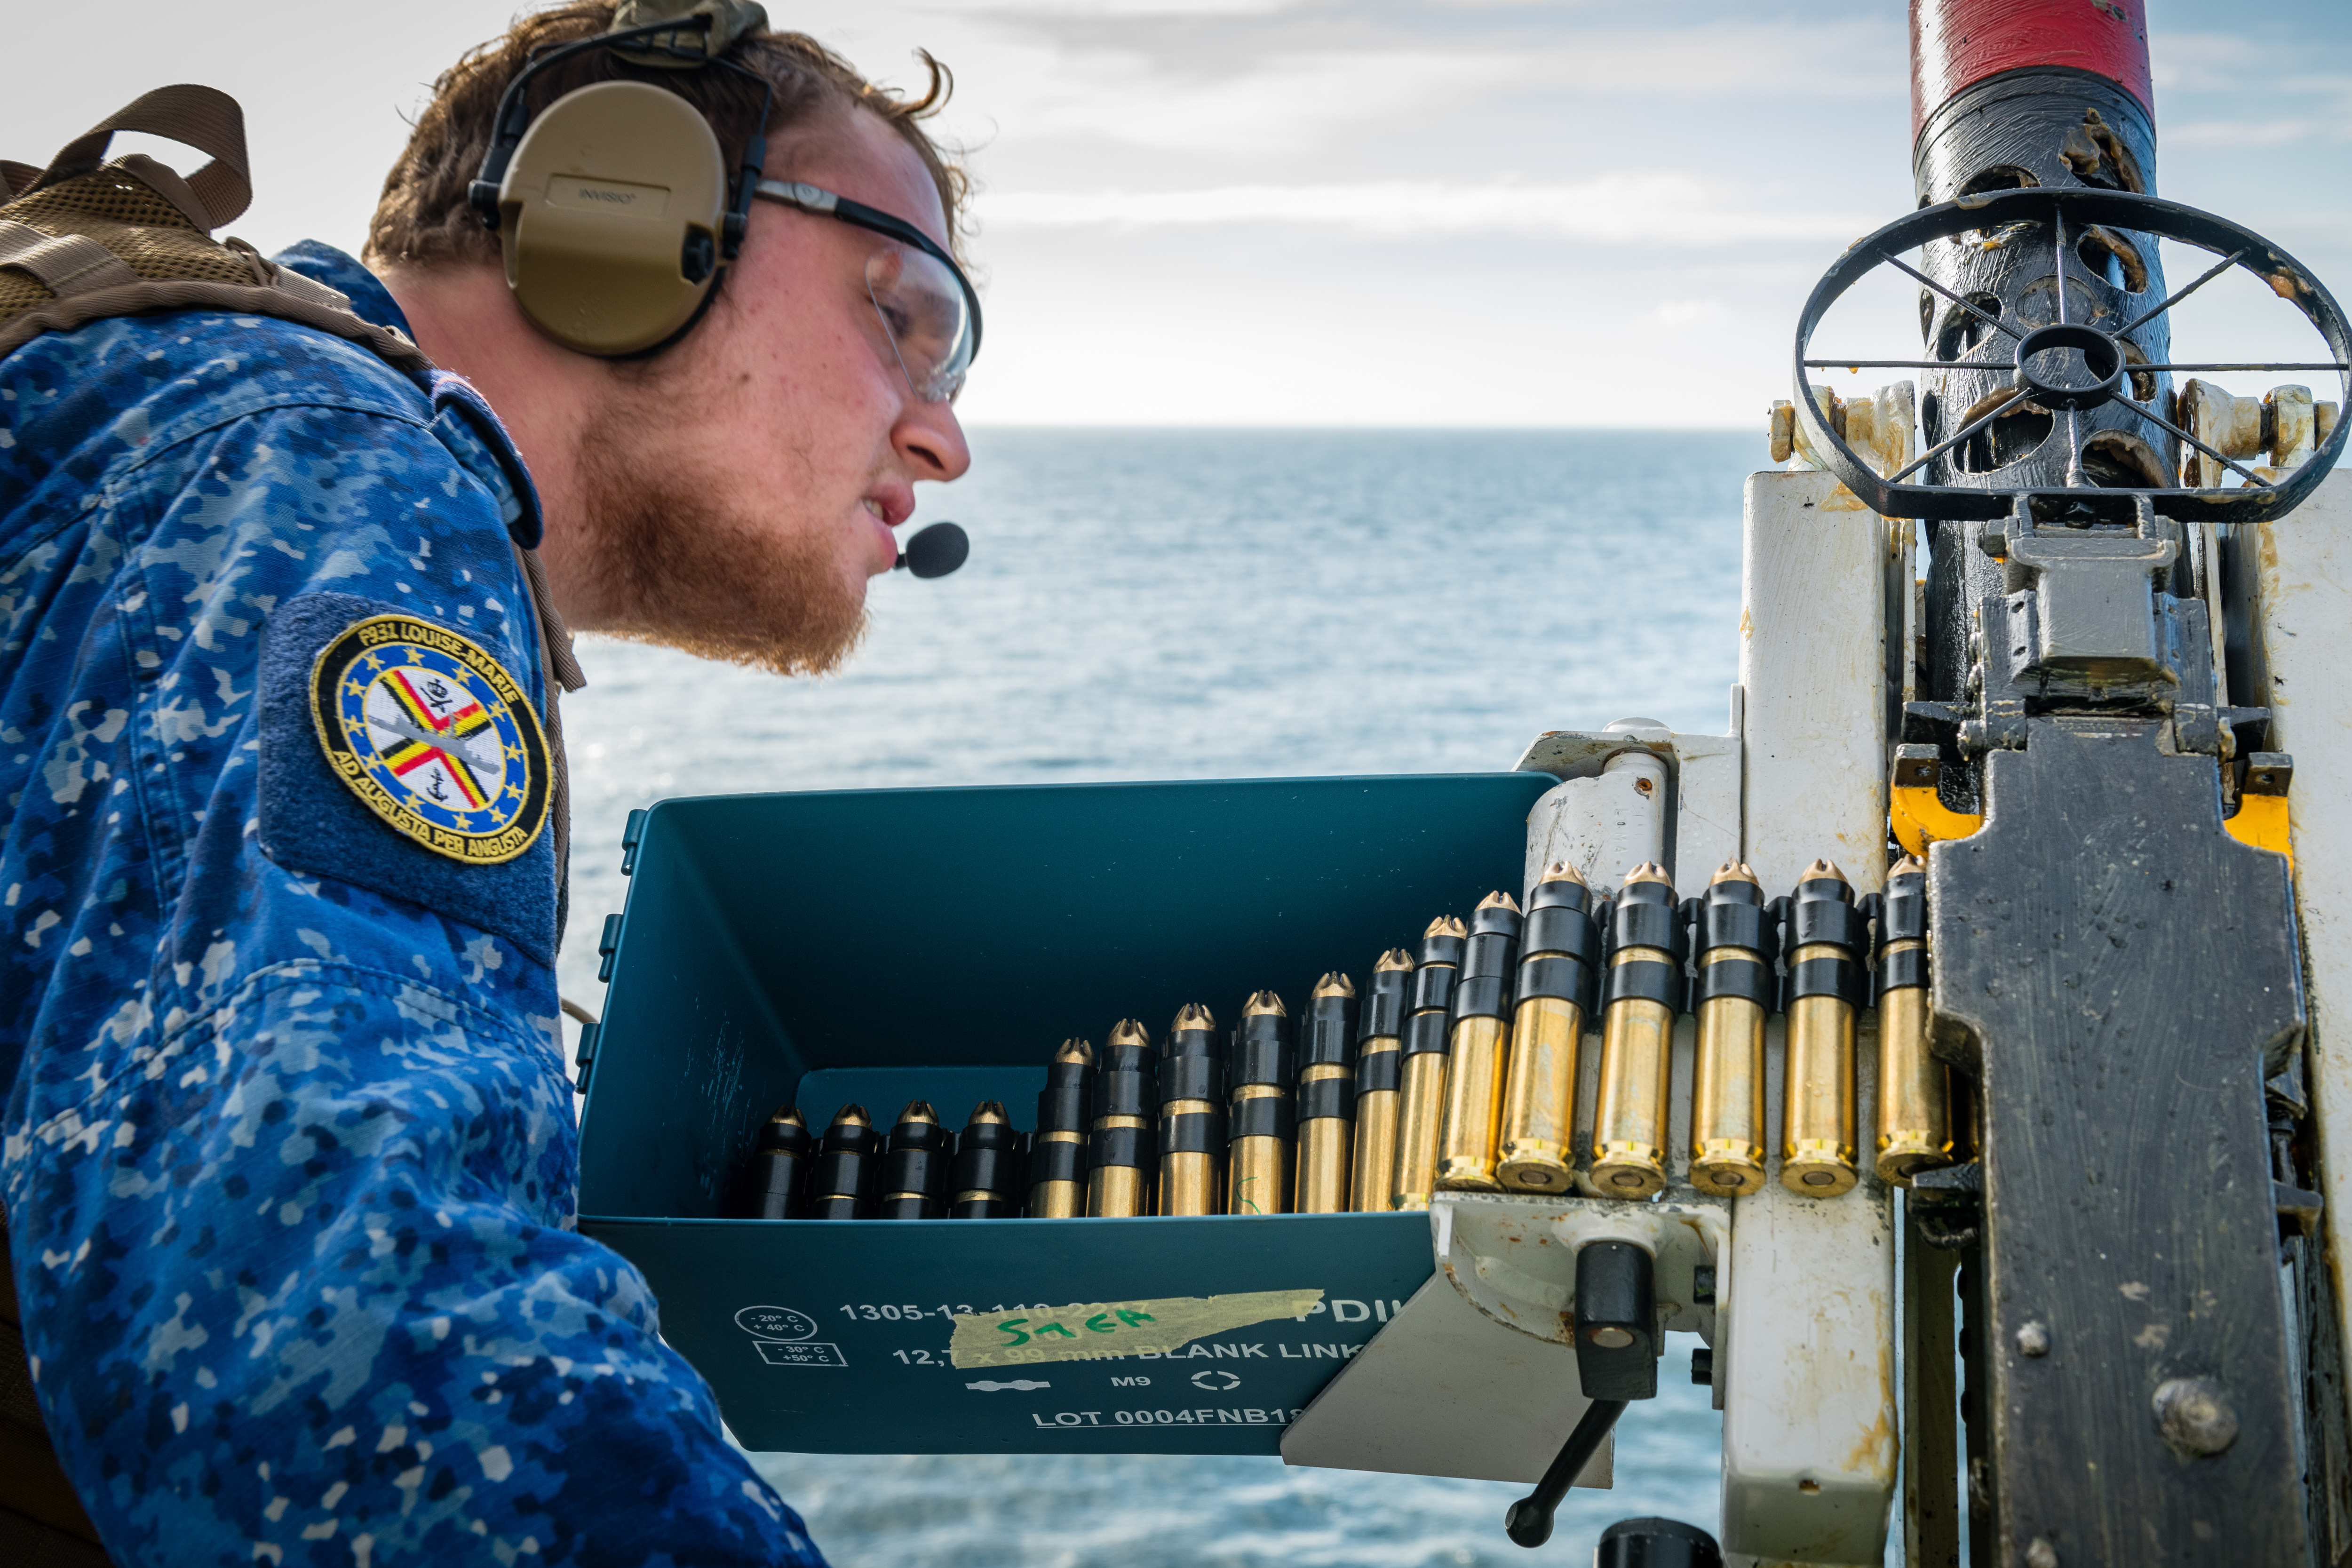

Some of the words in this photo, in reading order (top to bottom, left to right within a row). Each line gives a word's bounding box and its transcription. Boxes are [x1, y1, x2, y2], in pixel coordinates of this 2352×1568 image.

[358, 622, 399, 646] F931
[400, 626, 520, 704] LOUISE-MARIE
[333, 750, 360, 776] AD
[357, 777, 431, 842] AUGUSTA
[434, 829, 465, 854] PER
[467, 826, 528, 856] ANGUSTA
[1134, 1344, 1269, 1359] BLANK
[1111, 1377, 1151, 1387] M9
[1033, 1411, 1102, 1426] LOT
